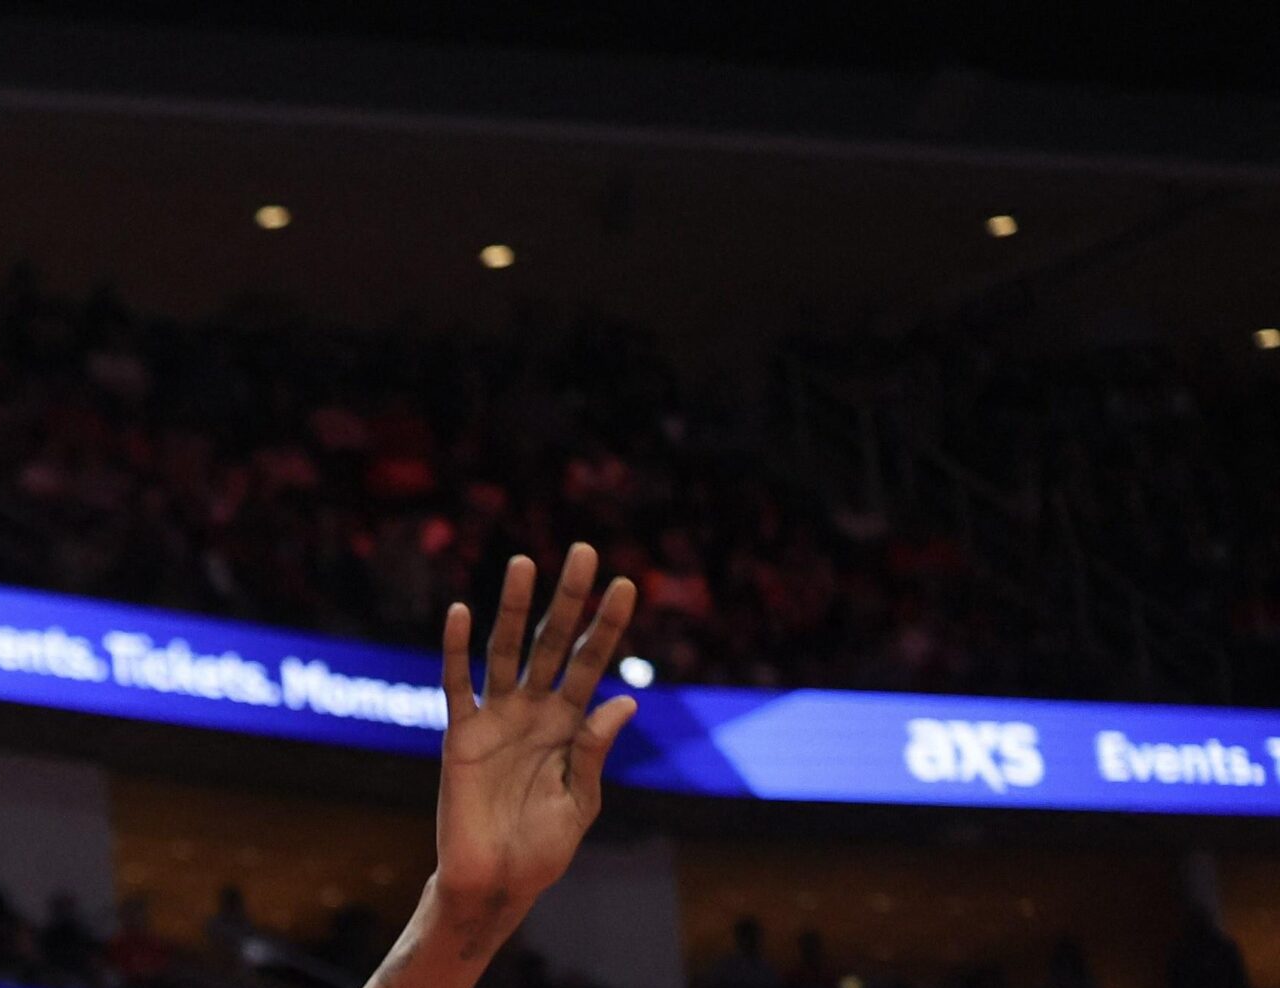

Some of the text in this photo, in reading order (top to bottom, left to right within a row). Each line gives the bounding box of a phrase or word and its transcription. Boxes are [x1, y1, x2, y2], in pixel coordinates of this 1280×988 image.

[102, 630, 282, 707] Tickets.
[280, 656, 449, 731] Momen
[905, 718, 1045, 794] axs
[1096, 730, 1266, 787] Events.
